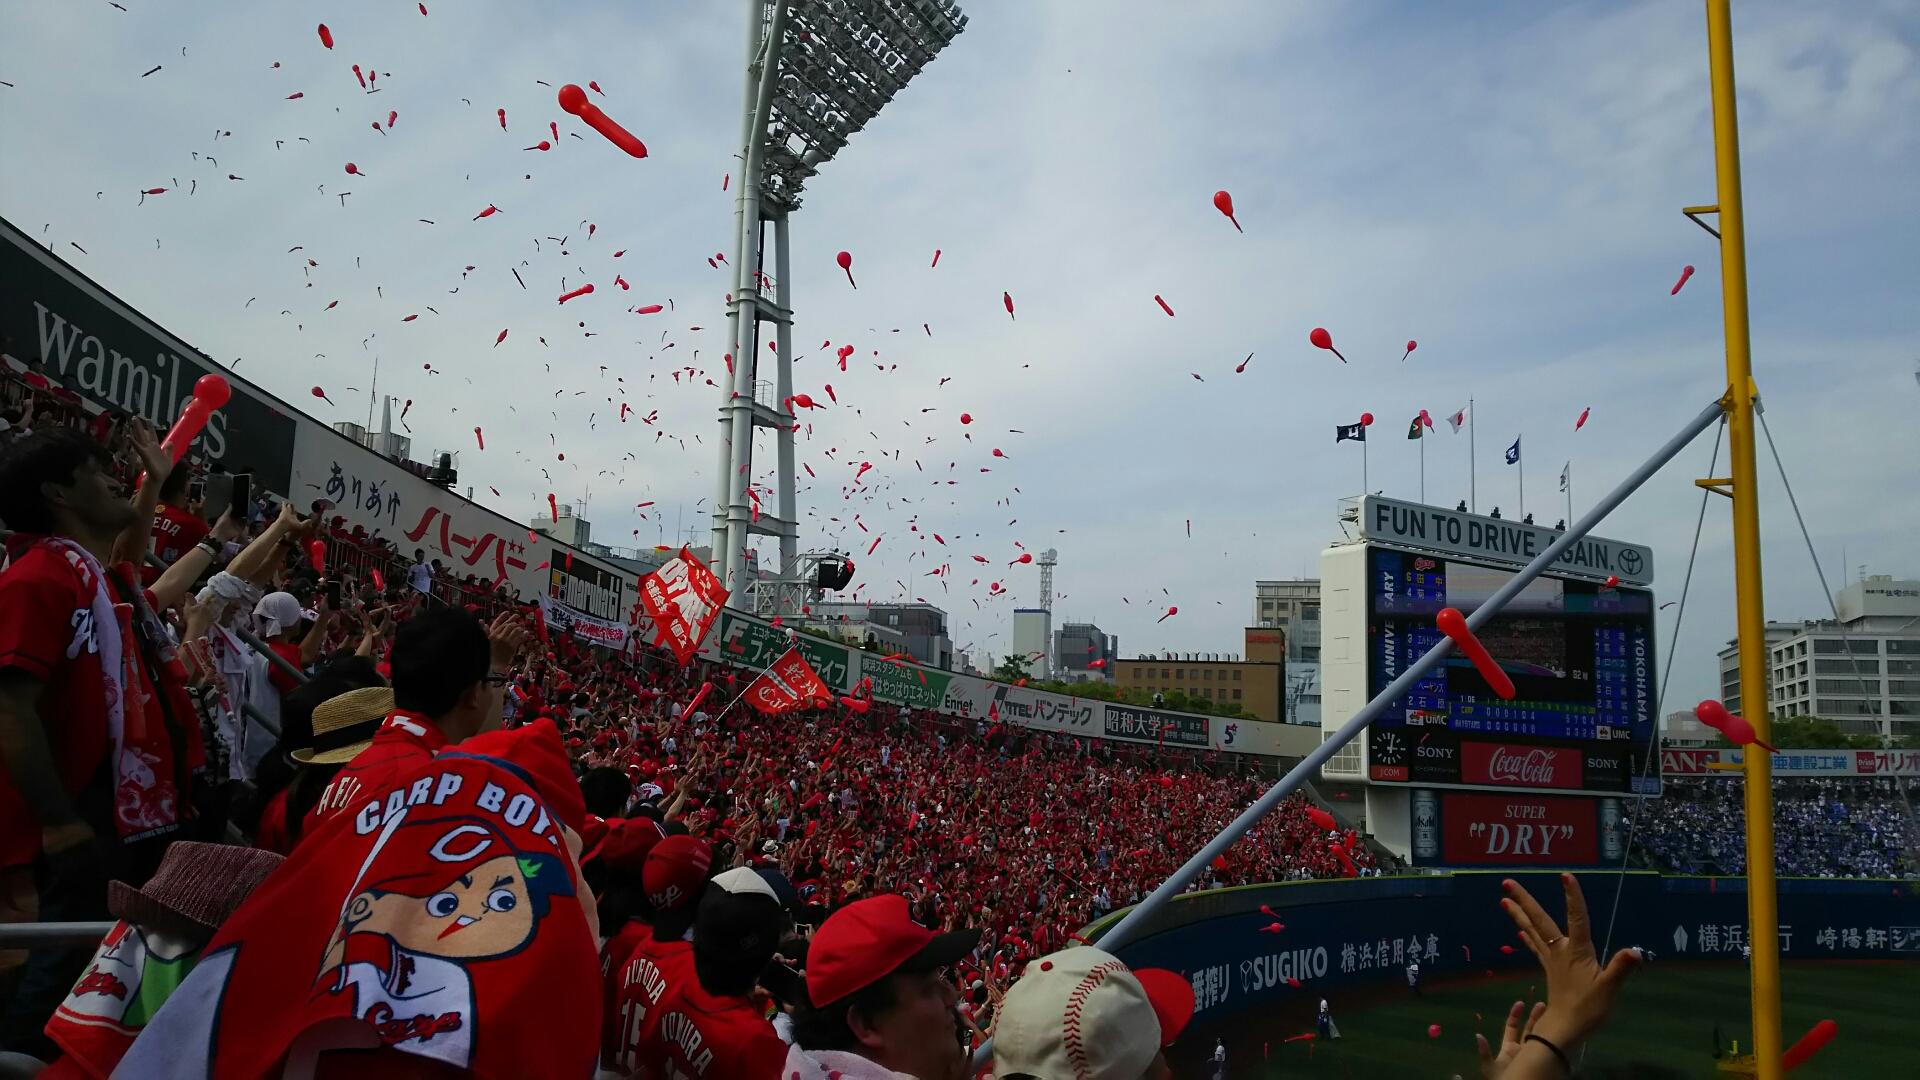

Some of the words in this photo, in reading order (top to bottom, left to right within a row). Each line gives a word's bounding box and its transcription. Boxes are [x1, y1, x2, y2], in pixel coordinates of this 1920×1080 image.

[153, 516, 182, 537] EDA
[1376, 504, 1426, 539] FUN
[1432, 514, 1461, 545] TO
[1635, 638, 1649, 723] YOKOHAMA
[944, 694, 973, 712] Ennet
[1105, 709, 1161, 737] 昭和大学
[1425, 715, 1448, 725] UMC
[1612, 729, 1631, 740] UMC
[1417, 746, 1454, 759] SONY
[1489, 746, 1558, 784] Coca-Cola
[1588, 758, 1619, 769] SONY
[1770, 754, 1848, 771] 亜建設工業
[355, 773, 464, 836] CARP
[1505, 804, 1547, 819] SUPER
[428, 824, 492, 862] C
[1698, 924, 1793, 953] 横浜行
[1816, 926, 1888, 951] 崎陽軒
[1340, 933, 1441, 974] 横浜信用金庫
[1252, 945, 1329, 992] SUGIKO
[1192, 963, 1231, 1014] 番搾り
